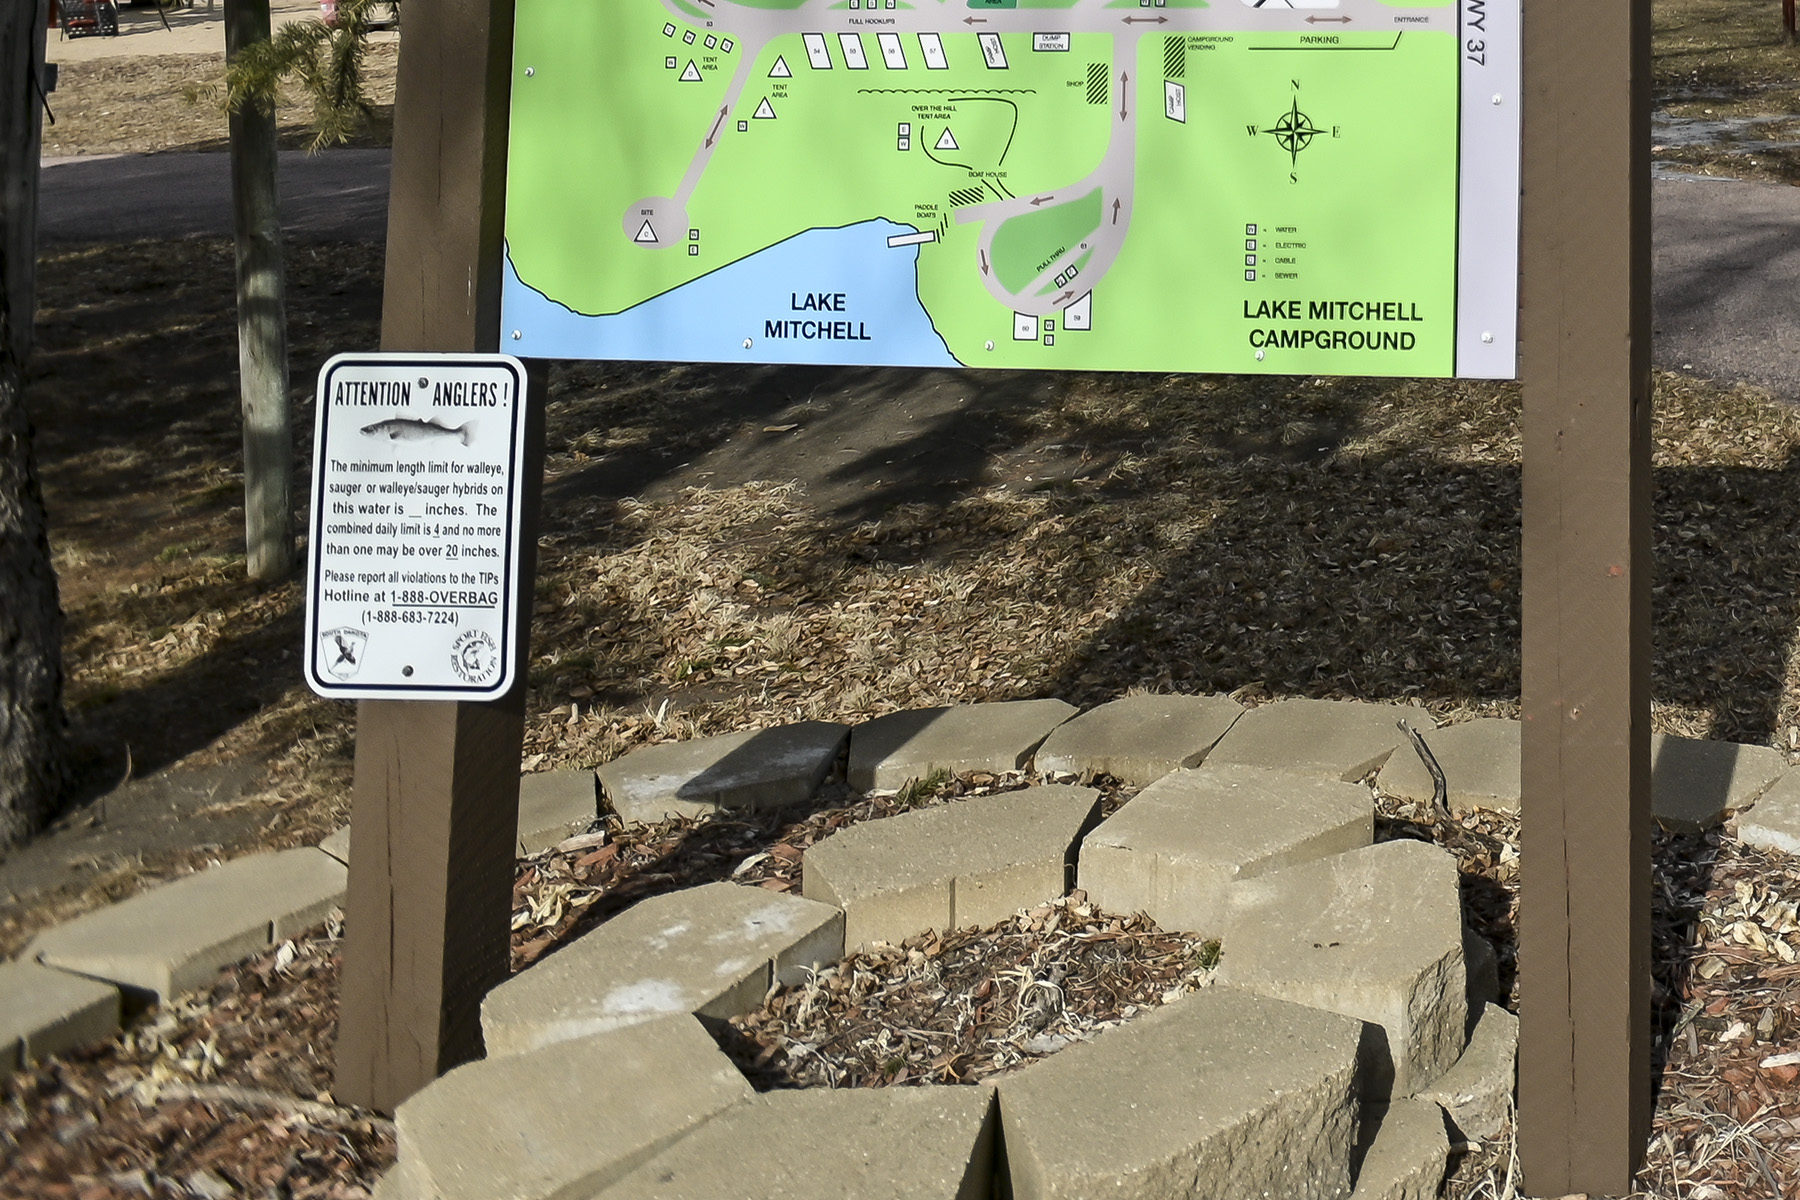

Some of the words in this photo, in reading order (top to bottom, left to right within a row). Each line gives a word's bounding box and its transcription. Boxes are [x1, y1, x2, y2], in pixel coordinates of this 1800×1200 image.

[1300, 36, 1339, 44] PARKING
[1467, 39, 1485, 66] 37
[1291, 79, 1300, 90] N
[1247, 125, 1259, 137] W
[1332, 126, 1341, 138] E
[1289, 172, 1297, 184] S
[791, 293, 846, 311] LAKE
[1243, 300, 1301, 319] LAKE
[1308, 301, 1423, 322] MITCHELL
[764, 320, 872, 340] MITCHELL
[1249, 329, 1416, 350] CAMPGROUND
[335, 381, 411, 406] ATTENTION
[433, 382, 498, 407] ANGLERS
[331, 459, 348, 473] The
[350, 460, 393, 473] minimum
[396, 461, 426, 477] length
[428, 461, 448, 474] limit
[451, 461, 464, 474] for
[466, 462, 504, 477] walleye,
[329, 483, 362, 497] sauger
[366, 484, 376, 494] or
[379, 481, 450, 498] walleye/sauger
[452, 482, 488, 498] hybrids
[491, 486, 503, 495] on
[332, 501, 354, 515] this
[358, 503, 390, 515] water
[394, 502, 404, 515] is
[425, 502, 468, 516] inches.
[475, 503, 497, 516] The
[326, 522, 373, 535] combined
[375, 522, 398, 538] daily
[400, 523, 421, 536] limit
[423, 523, 431, 536] is
[433, 523, 440, 537] 4
[442, 524, 460, 536] and
[462, 526, 474, 536] no
[477, 526, 501, 536] more
[326, 542, 349, 555] than
[353, 544, 373, 555] one
[376, 545, 399, 559] may
[402, 543, 415, 556] be
[418, 546, 442, 556] over
[446, 544, 458, 557] 20
[461, 544, 499, 558] inches.
[324, 569, 355, 582] Please
[357, 571, 385, 585] report
[388, 571, 399, 583] all
[402, 572, 446, 584] violations
[450, 572, 458, 584] to
[461, 572, 476, 584] the
[479, 572, 499, 585] TIPs
[324, 589, 369, 603] Hotline
[374, 590, 386, 603] at
[390, 590, 498, 605] 1-888-OVERBAG
[361, 609, 459, 627] (1-888-683-7224)
[344, 629, 368, 638] DAKOTA
[452, 629, 478, 650] SPORT
